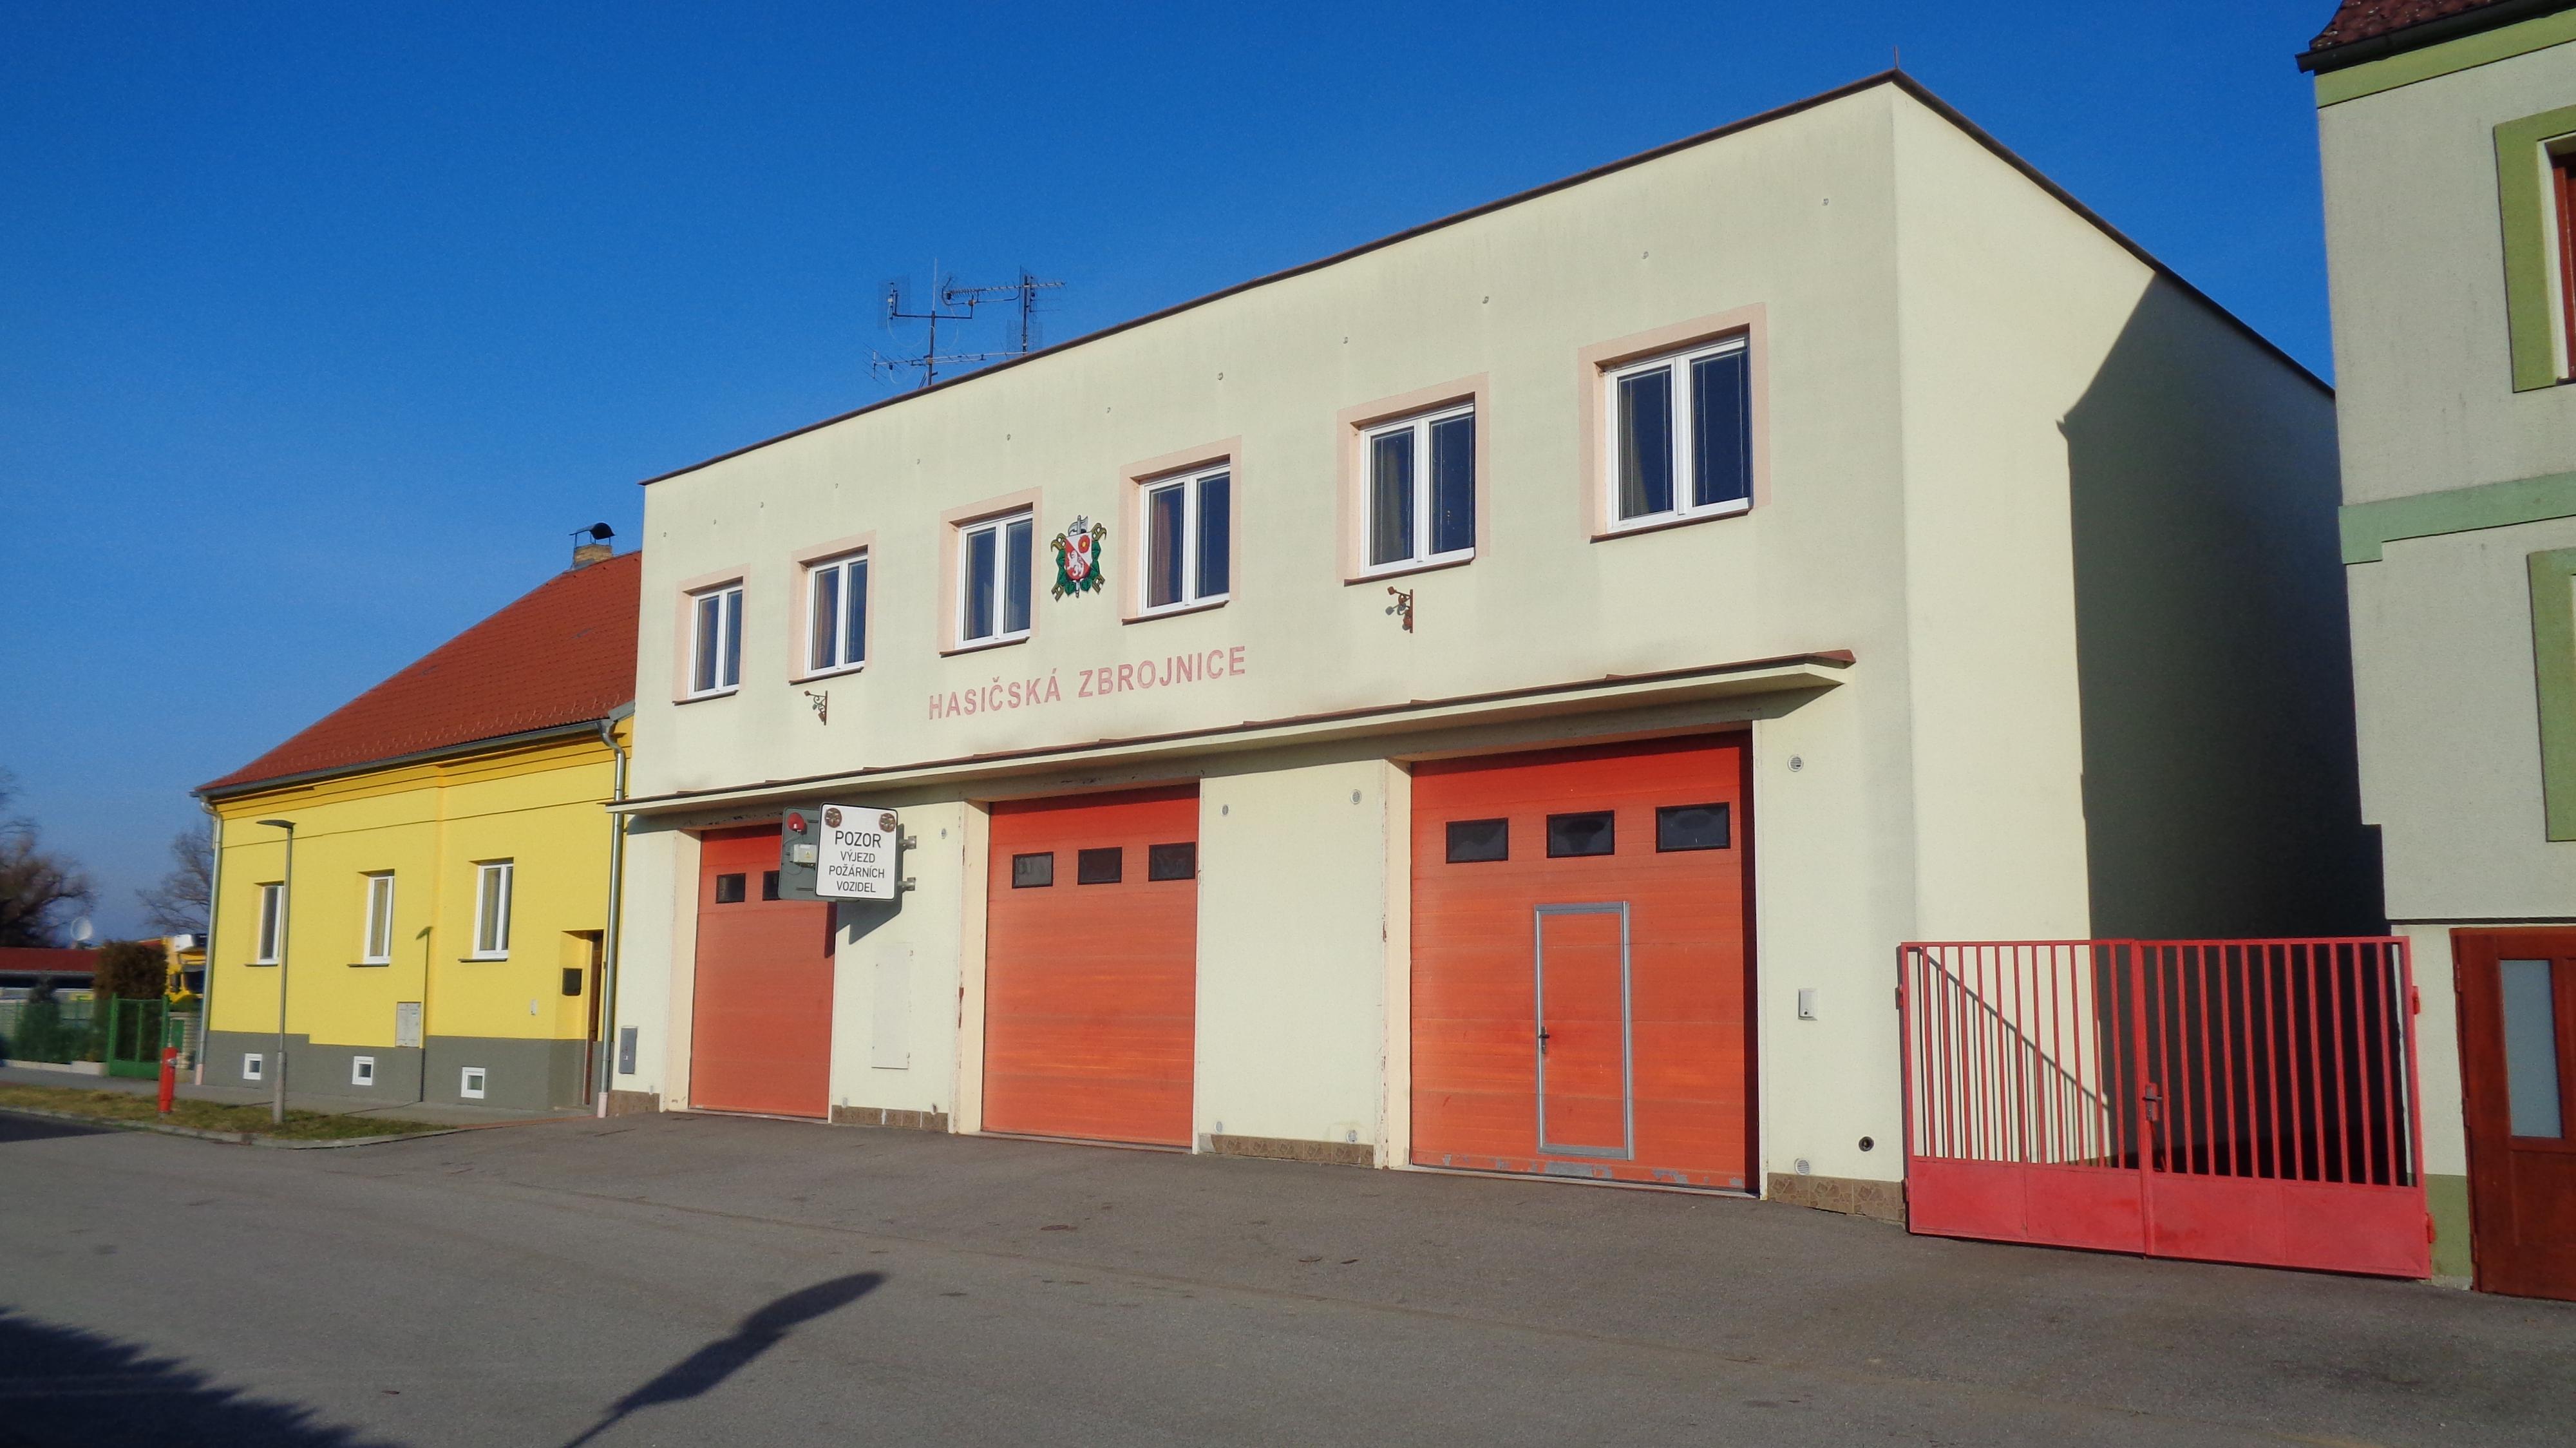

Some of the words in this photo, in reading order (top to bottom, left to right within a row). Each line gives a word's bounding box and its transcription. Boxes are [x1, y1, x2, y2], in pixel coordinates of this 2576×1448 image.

[928, 667, 1061, 719] HASIČSKÁ
[1078, 645, 1245, 698] ZBROJNICE
[835, 830, 881, 848] POZOR
[840, 849, 876, 863] VÝJEZD
[828, 864, 885, 879] POŽÁRNÍCH
[837, 881, 876, 893] VOZIDEL
